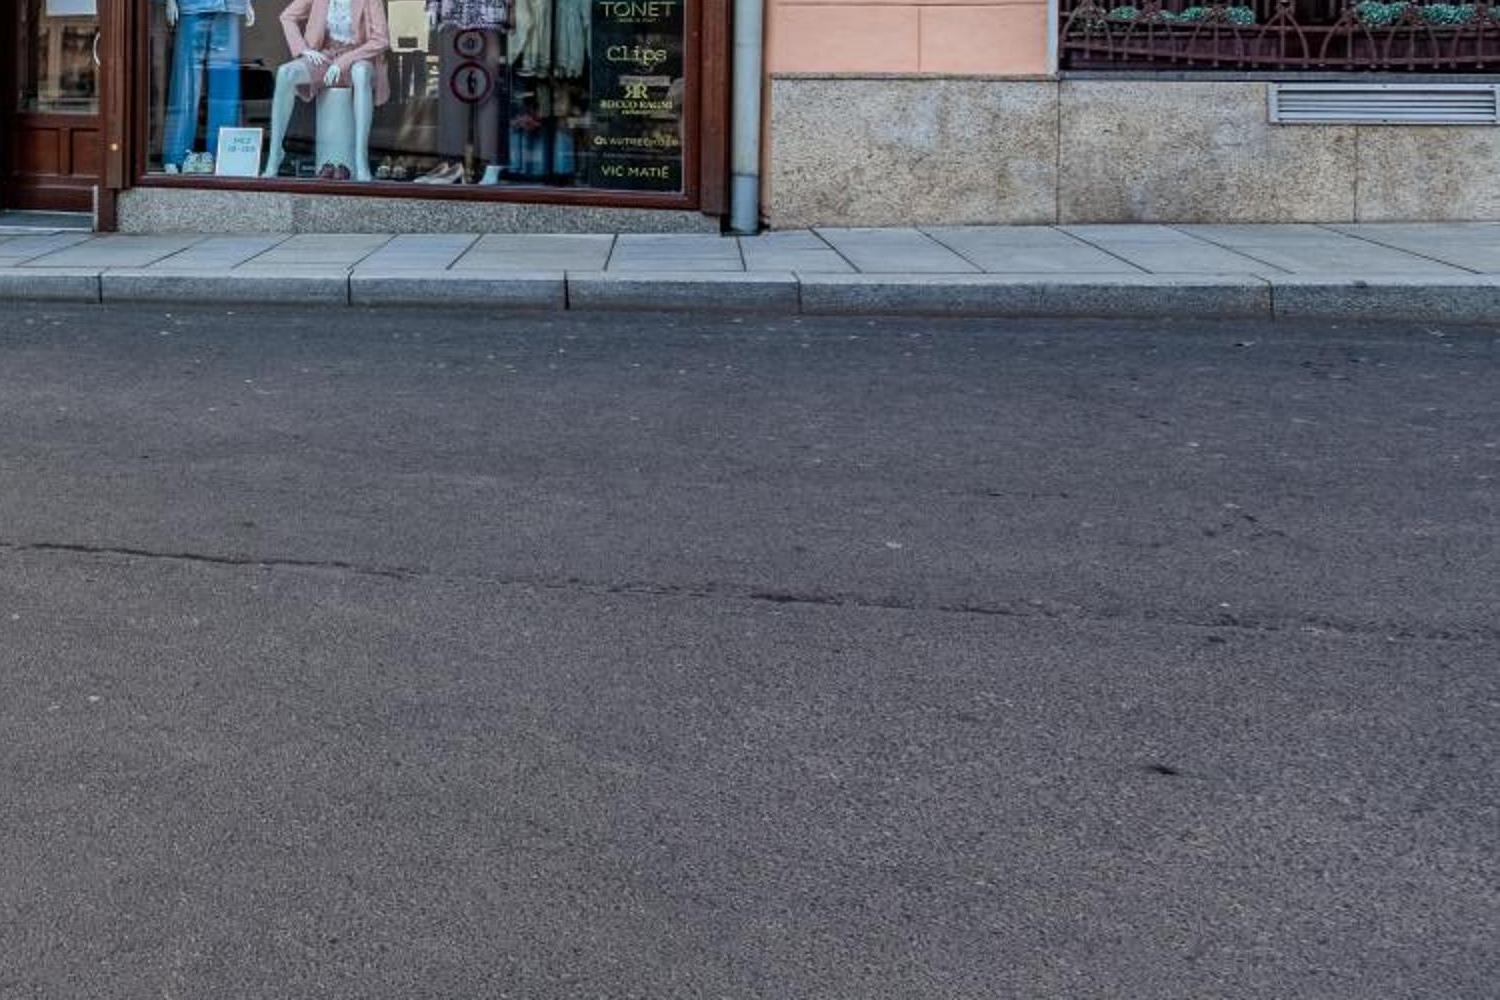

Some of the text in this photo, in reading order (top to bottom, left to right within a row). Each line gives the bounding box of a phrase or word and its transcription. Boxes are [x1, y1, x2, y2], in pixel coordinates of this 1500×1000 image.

[599, 1, 677, 18] TONET
[607, 44, 668, 67] Clips
[601, 165, 624, 178] VIC
